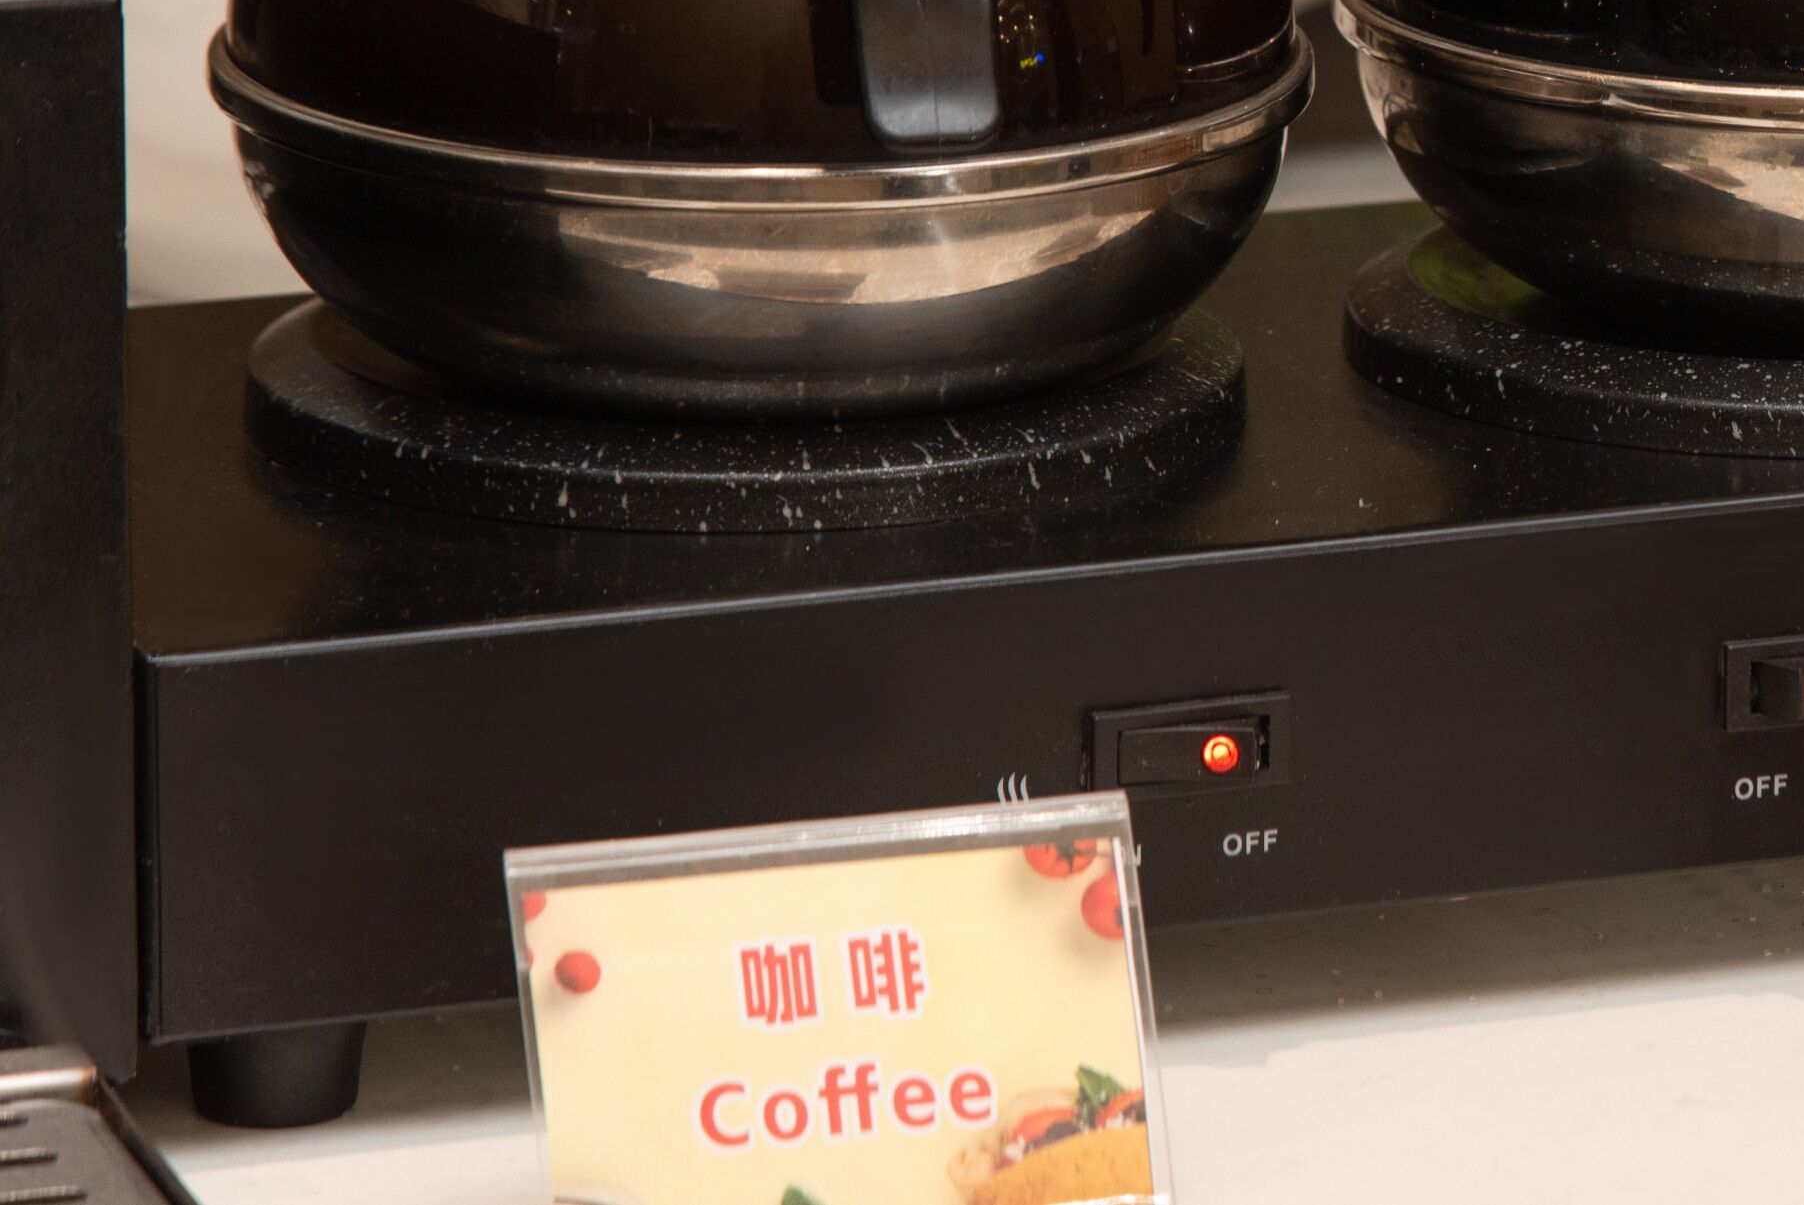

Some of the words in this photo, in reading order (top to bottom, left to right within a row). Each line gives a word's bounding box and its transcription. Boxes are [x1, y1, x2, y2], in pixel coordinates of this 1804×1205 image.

[1733, 773, 1789, 801] OFF
[1221, 828, 1279, 858] OFF
[738, 930, 925, 1025] 咖啡
[698, 1062, 993, 1147] Coffee
